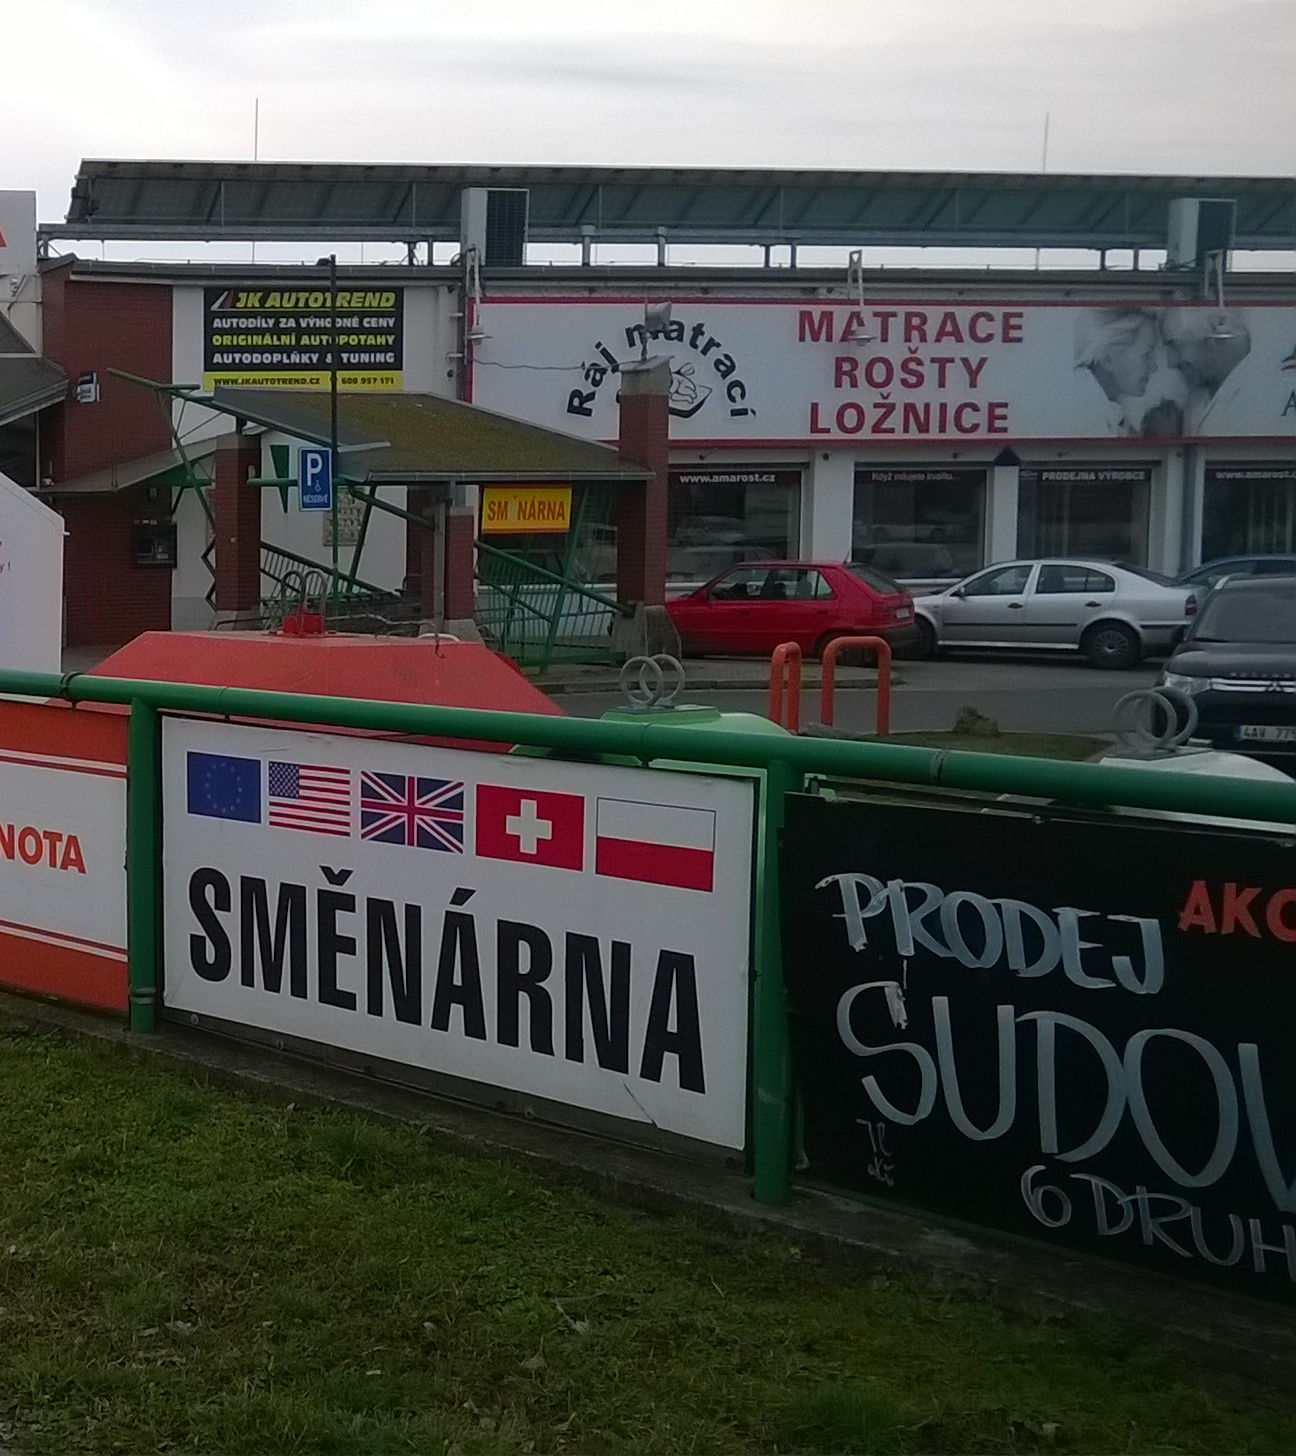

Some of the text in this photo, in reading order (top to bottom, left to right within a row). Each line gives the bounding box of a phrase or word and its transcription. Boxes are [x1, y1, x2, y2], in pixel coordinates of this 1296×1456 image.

[235, 291, 396, 308] JK AUTOTREND
[212, 316, 275, 328] AUTODÍLY
[279, 317, 296, 328] ZA
[362, 317, 396, 328] CENY
[212, 332, 296, 346] ORIGINÁLNÍ
[798, 310, 1024, 344] MATRACE
[212, 351, 320, 364] AUTODOPLŇKY
[341, 352, 395, 363] TUNING
[834, 346, 989, 389] ROŠTY
[809, 392, 1010, 434] LOŽNICE
[306, 452, 323, 487] P
[679, 473, 776, 484] www.amarost.cz
[814, 872, 1165, 995] PRODEJ
[188, 865, 707, 1095] SMĚNÁRNA
[1021, 1164, 1073, 1228] 6
